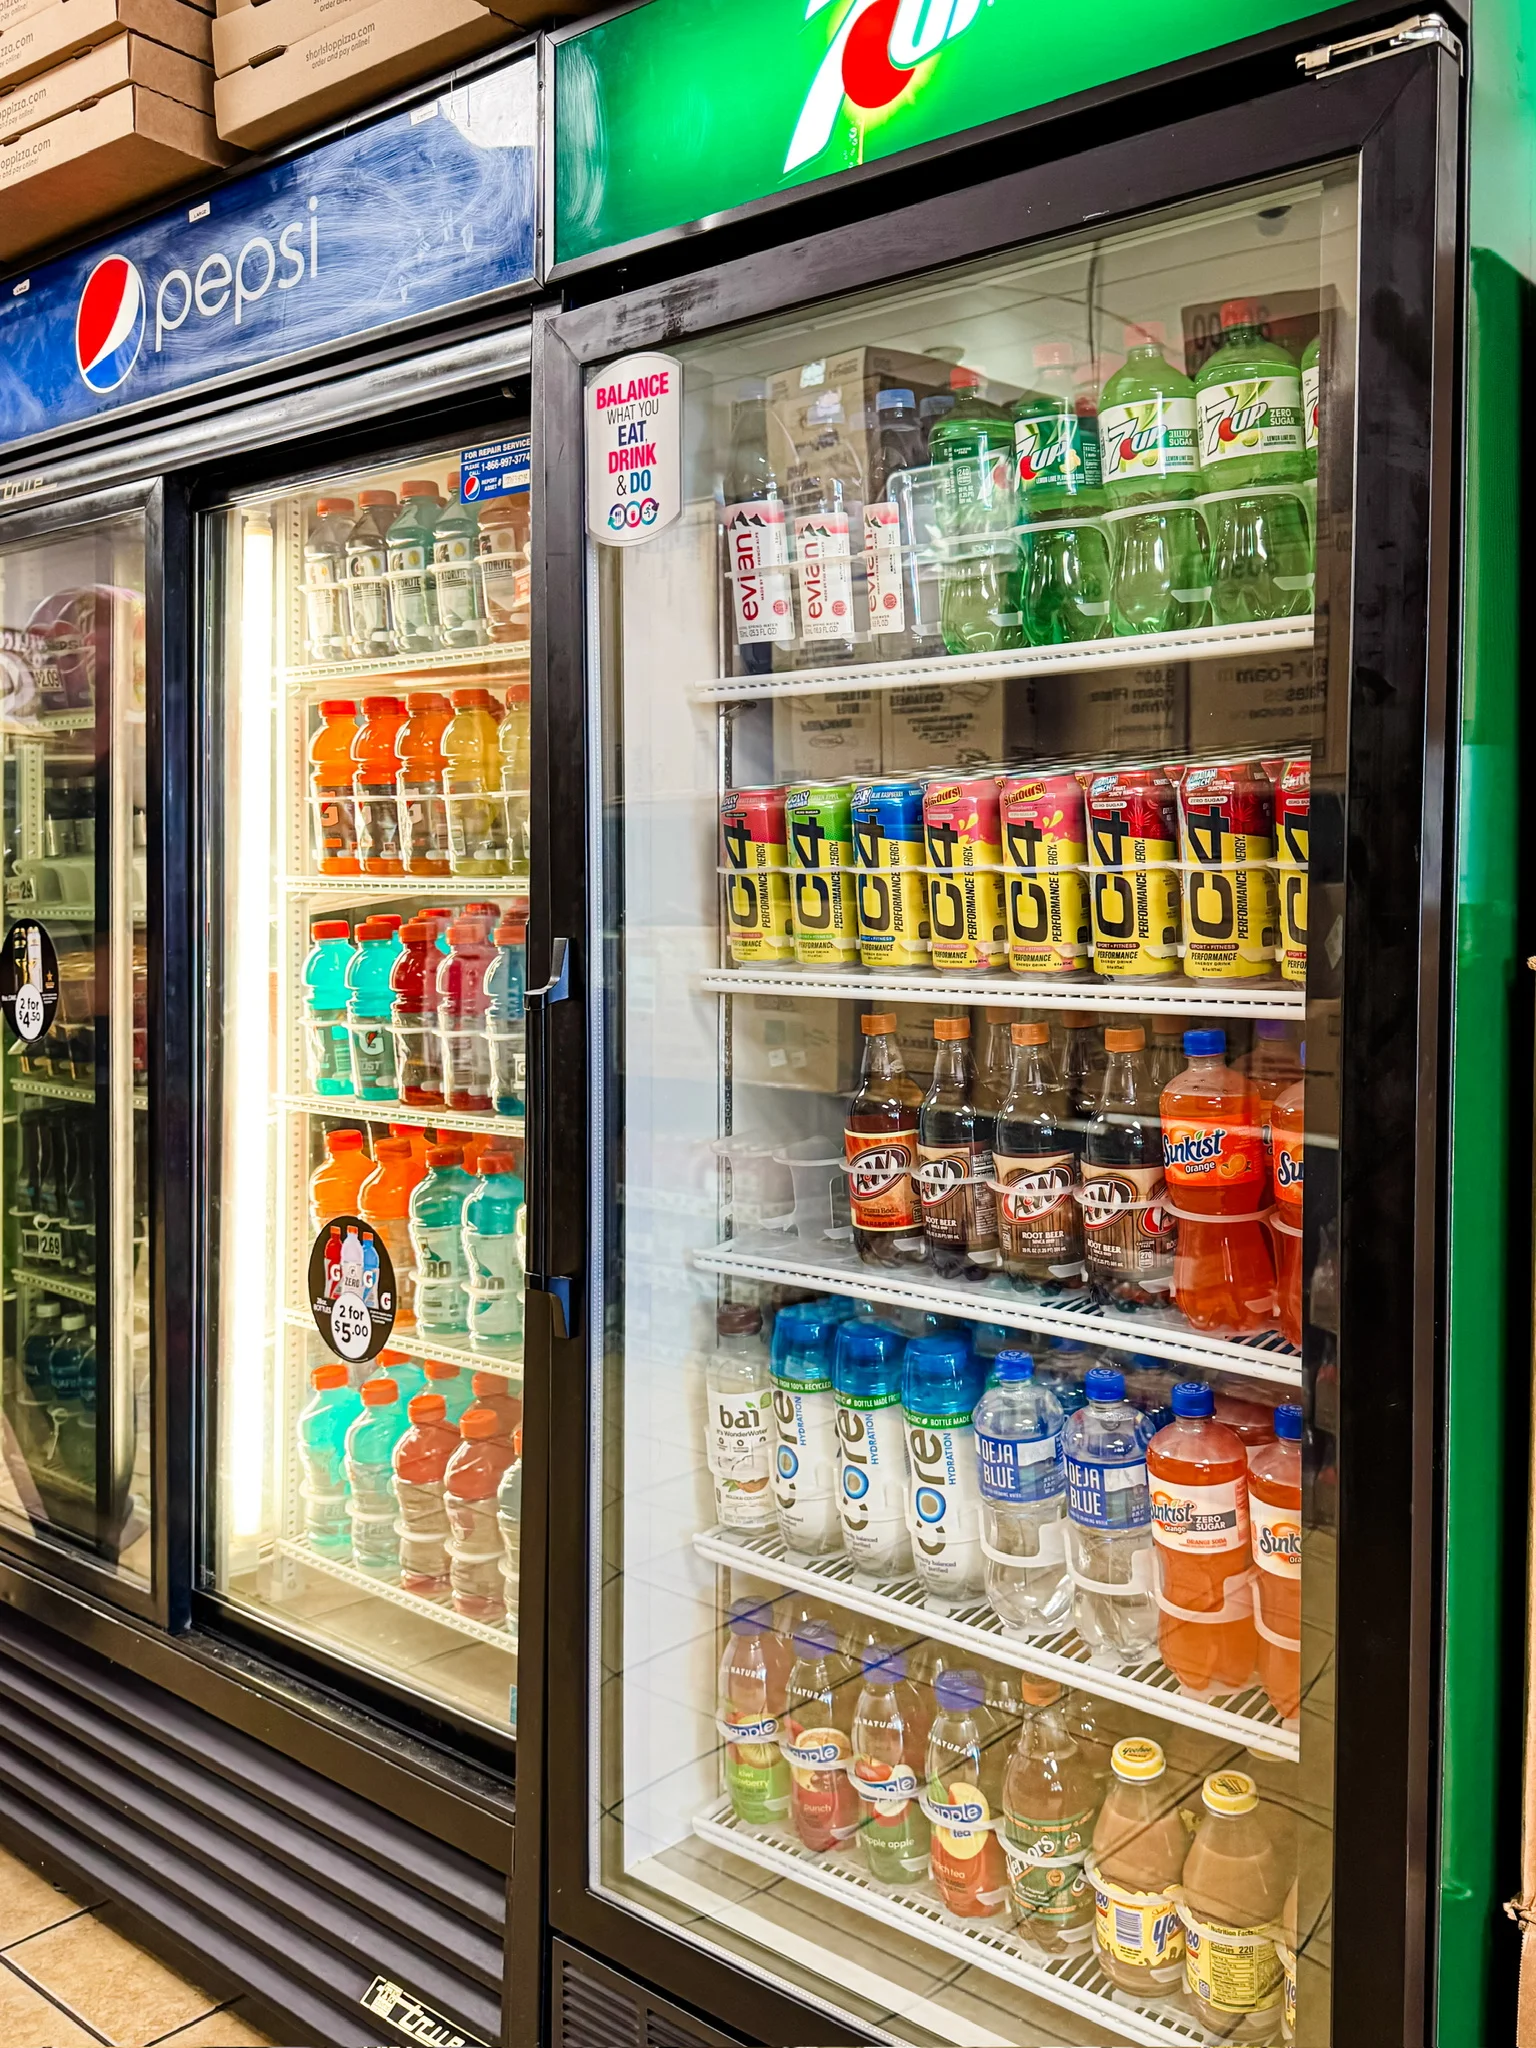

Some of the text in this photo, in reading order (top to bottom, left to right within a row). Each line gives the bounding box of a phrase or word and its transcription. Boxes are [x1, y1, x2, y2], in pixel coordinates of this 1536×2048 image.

[156, 196, 318, 352] pepsi
[596, 372, 669, 411] BALANCE
[607, 398, 660, 426] WHAT YOU
[1269, 409, 1292, 418] ZERO
[1270, 417, 1295, 426] SUGAR
[617, 420, 648, 448] EAT,
[1169, 437, 1193, 447] SUGAR
[478, 445, 501, 457] REPAIR
[503, 438, 530, 451] SERVICE
[608, 442, 657, 475] DRINK
[616, 469, 652, 497] & DO
[736, 533, 759, 621] evian
[805, 543, 822, 619] evian
[788, 790, 809, 804] JOLLY
[792, 816, 830, 930] C4
[855, 815, 891, 931] C4
[927, 822, 964, 940] C4
[1007, 820, 1048, 943] C4
[1092, 810, 1135, 939] C4
[1187, 807, 1233, 940] C4
[757, 871, 772, 929] PERFORMANCE
[829, 871, 844, 929] PERFORMANCE
[888, 871, 904, 932] PERFORMANCE
[964, 877, 978, 940] PERFORMANCE
[1050, 876, 1063, 942] PERFORMANCE
[1136, 872, 1150, 939] PERFORMANCE
[1236, 870, 1249, 940] PERFORMANCE
[732, 940, 762, 948] PERFORMANCE
[799, 941, 835, 950] PERFORMANCE
[861, 943, 893, 952] PERFORMANCE
[934, 951, 967, 959] PERFORMANCE
[1097, 951, 1138, 959] PERFORMANCE
[1191, 952, 1237, 961] PERFORMANCE
[1013, 953, 1052, 962] PERFORMANCE
[20, 998, 25, 1009] 2
[28, 997, 39, 1011] for
[19, 1010, 41, 1028] $4.50
[1163, 1128, 1226, 1168] Sunkist
[1185, 1161, 1216, 1175] Orange
[939, 1218, 957, 1227] BEER
[1022, 1230, 1064, 1239] ROOT BEER
[1103, 1244, 1121, 1253] BEER
[330, 1264, 340, 1281] G
[345, 1276, 360, 1288] ZERO
[340, 1305, 346, 1318] 2
[349, 1305, 365, 1321] for
[335, 1319, 369, 1344] $5.00
[790, 1381, 803, 1390] 100%
[804, 1381, 832, 1390] RECYCLED
[853, 1396, 888, 1407] BOTTLE MADE
[720, 1404, 760, 1429] bai
[794, 1395, 807, 1447] HYDRATION
[930, 1416, 970, 1426] BOTTLE MADE
[864, 1413, 880, 1466] HYDRATION
[942, 1432, 956, 1486] HYDRATION
[981, 1440, 1014, 1466] DEJA
[839, 1408, 870, 1531] core
[983, 1465, 1016, 1490] BLUE
[1068, 1460, 1100, 1491] DEJA
[909, 1428, 947, 1556] core
[1070, 1486, 1103, 1516] BLUE
[1164, 1524, 1187, 1534] Orange
[1196, 1522, 1226, 1531] SUGAR
[887, 1837, 915, 1849] apple
[953, 1828, 972, 1838] tea
[950, 1869, 966, 1879] tea
[1210, 1925, 1254, 1936] Nutrition Facts
[1210, 1942, 1254, 1954] Calories 220
